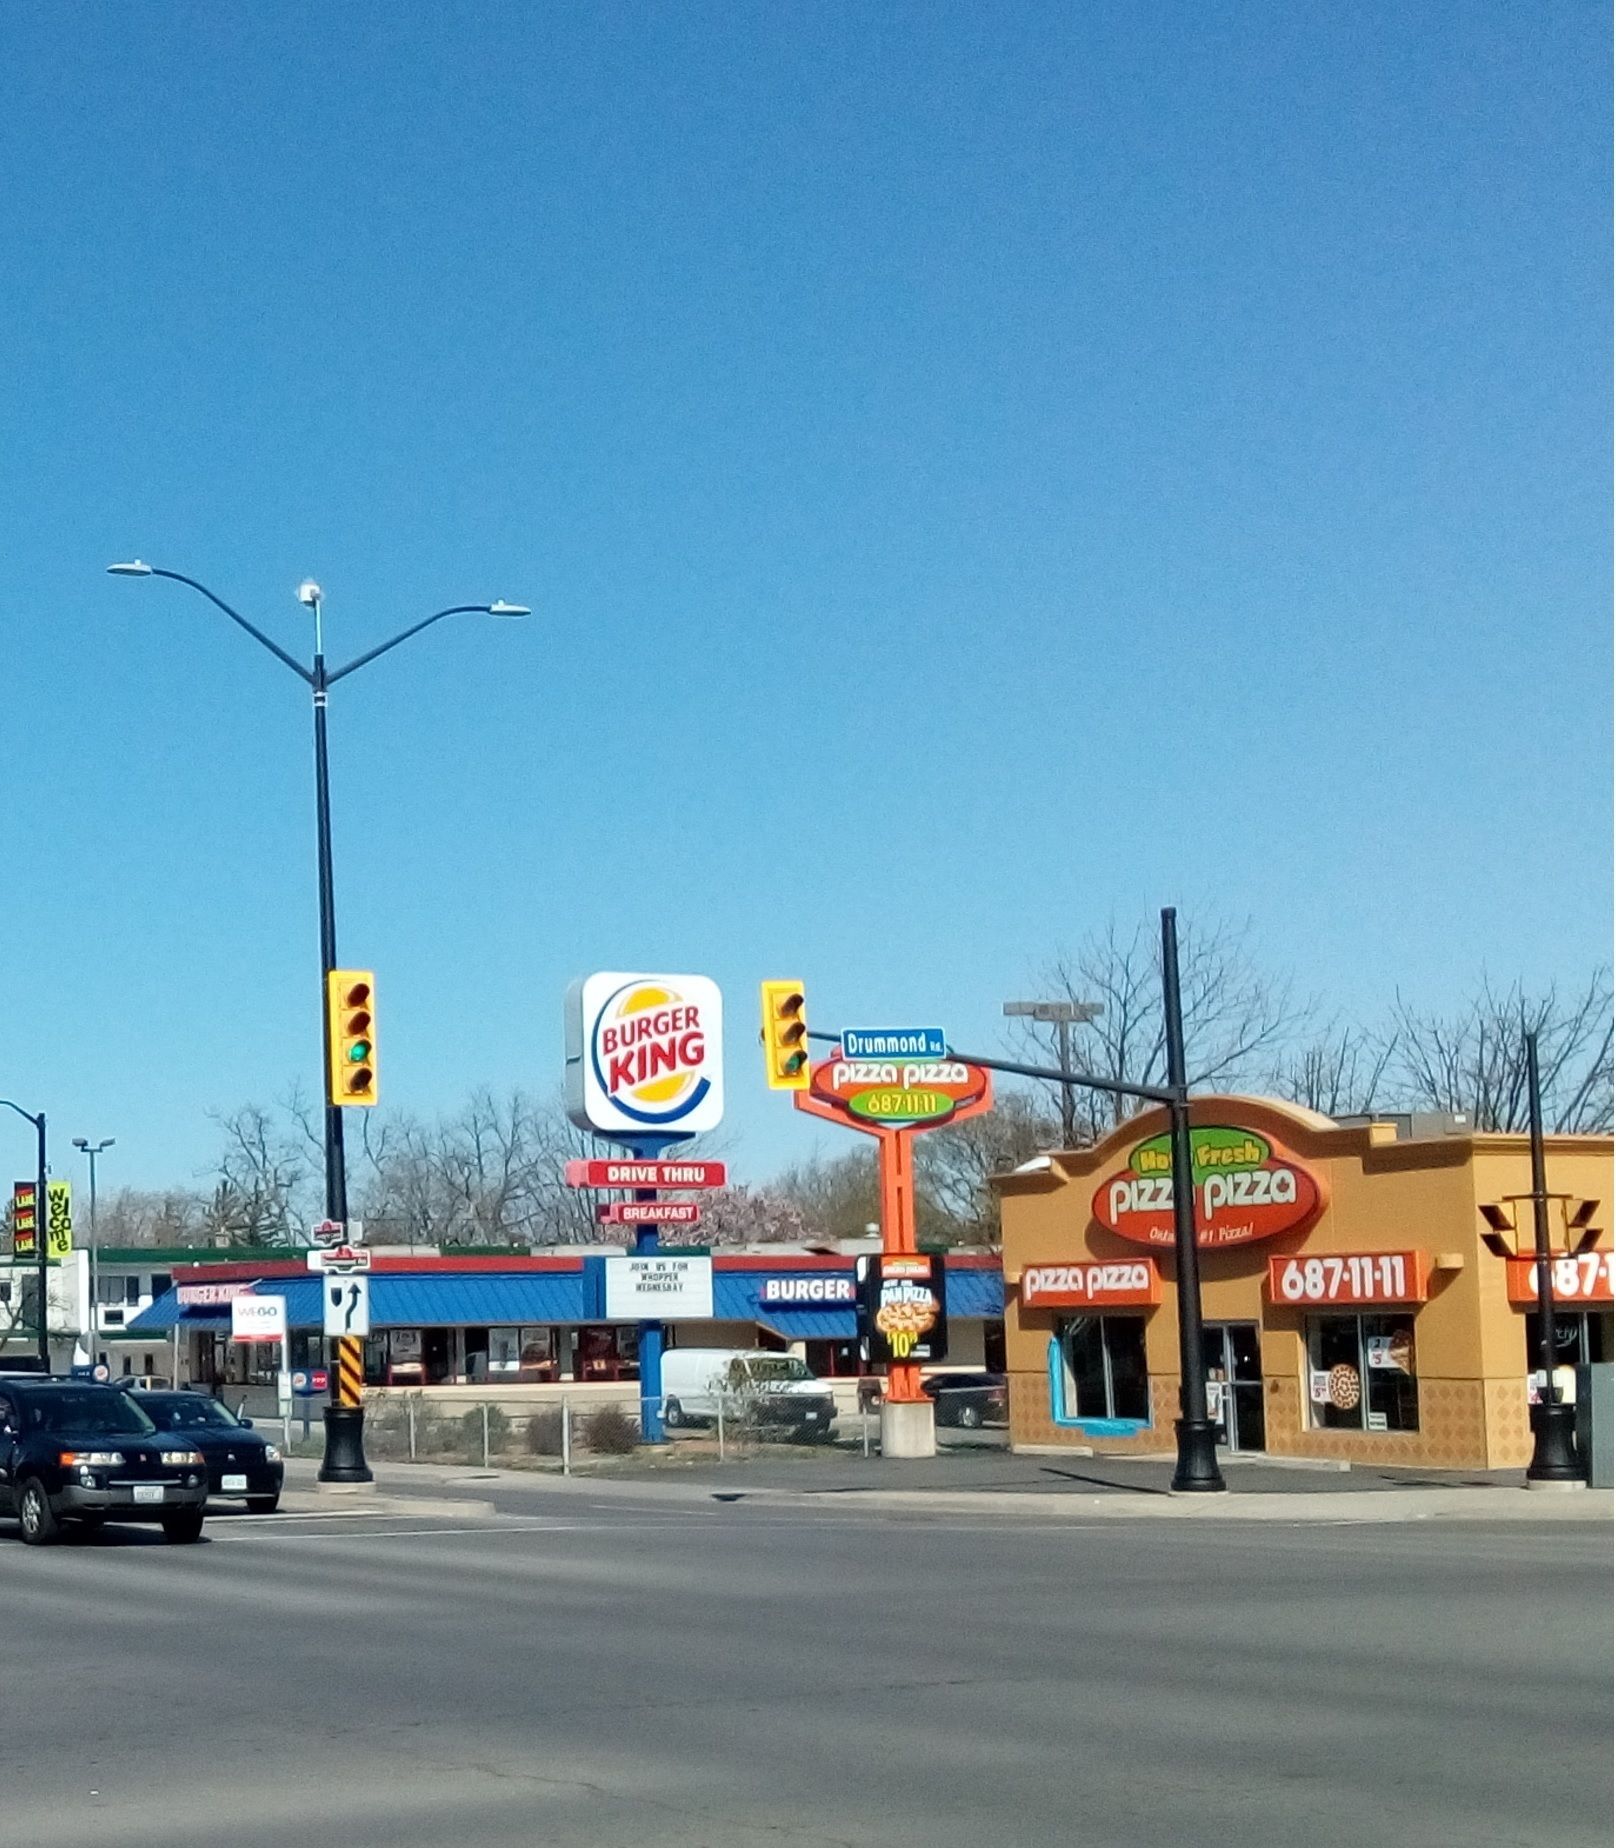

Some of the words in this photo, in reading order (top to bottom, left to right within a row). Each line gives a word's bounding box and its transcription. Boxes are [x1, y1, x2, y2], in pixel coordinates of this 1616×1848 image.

[602, 1005, 700, 1056] BURGER
[847, 1031, 927, 1054] Drummond
[610, 1031, 705, 1093] KING
[833, 1062, 898, 1090] pizza
[903, 1062, 969, 1090] pizza
[1139, 1150, 1172, 1171] Ho
[1196, 1139, 1261, 1166] Fresh
[607, 1166, 657, 1181] DRIVE
[662, 1166, 705, 1181] THRU
[1110, 1178, 1196, 1225] pizz
[1204, 1169, 1297, 1220] pizza
[623, 1206, 694, 1219] BREAKFAST
[1199, 1228, 1214, 1242] #1
[766, 1279, 850, 1300] BURGER
[1025, 1267, 1084, 1300] pizza
[1087, 1265, 1149, 1299] pizza
